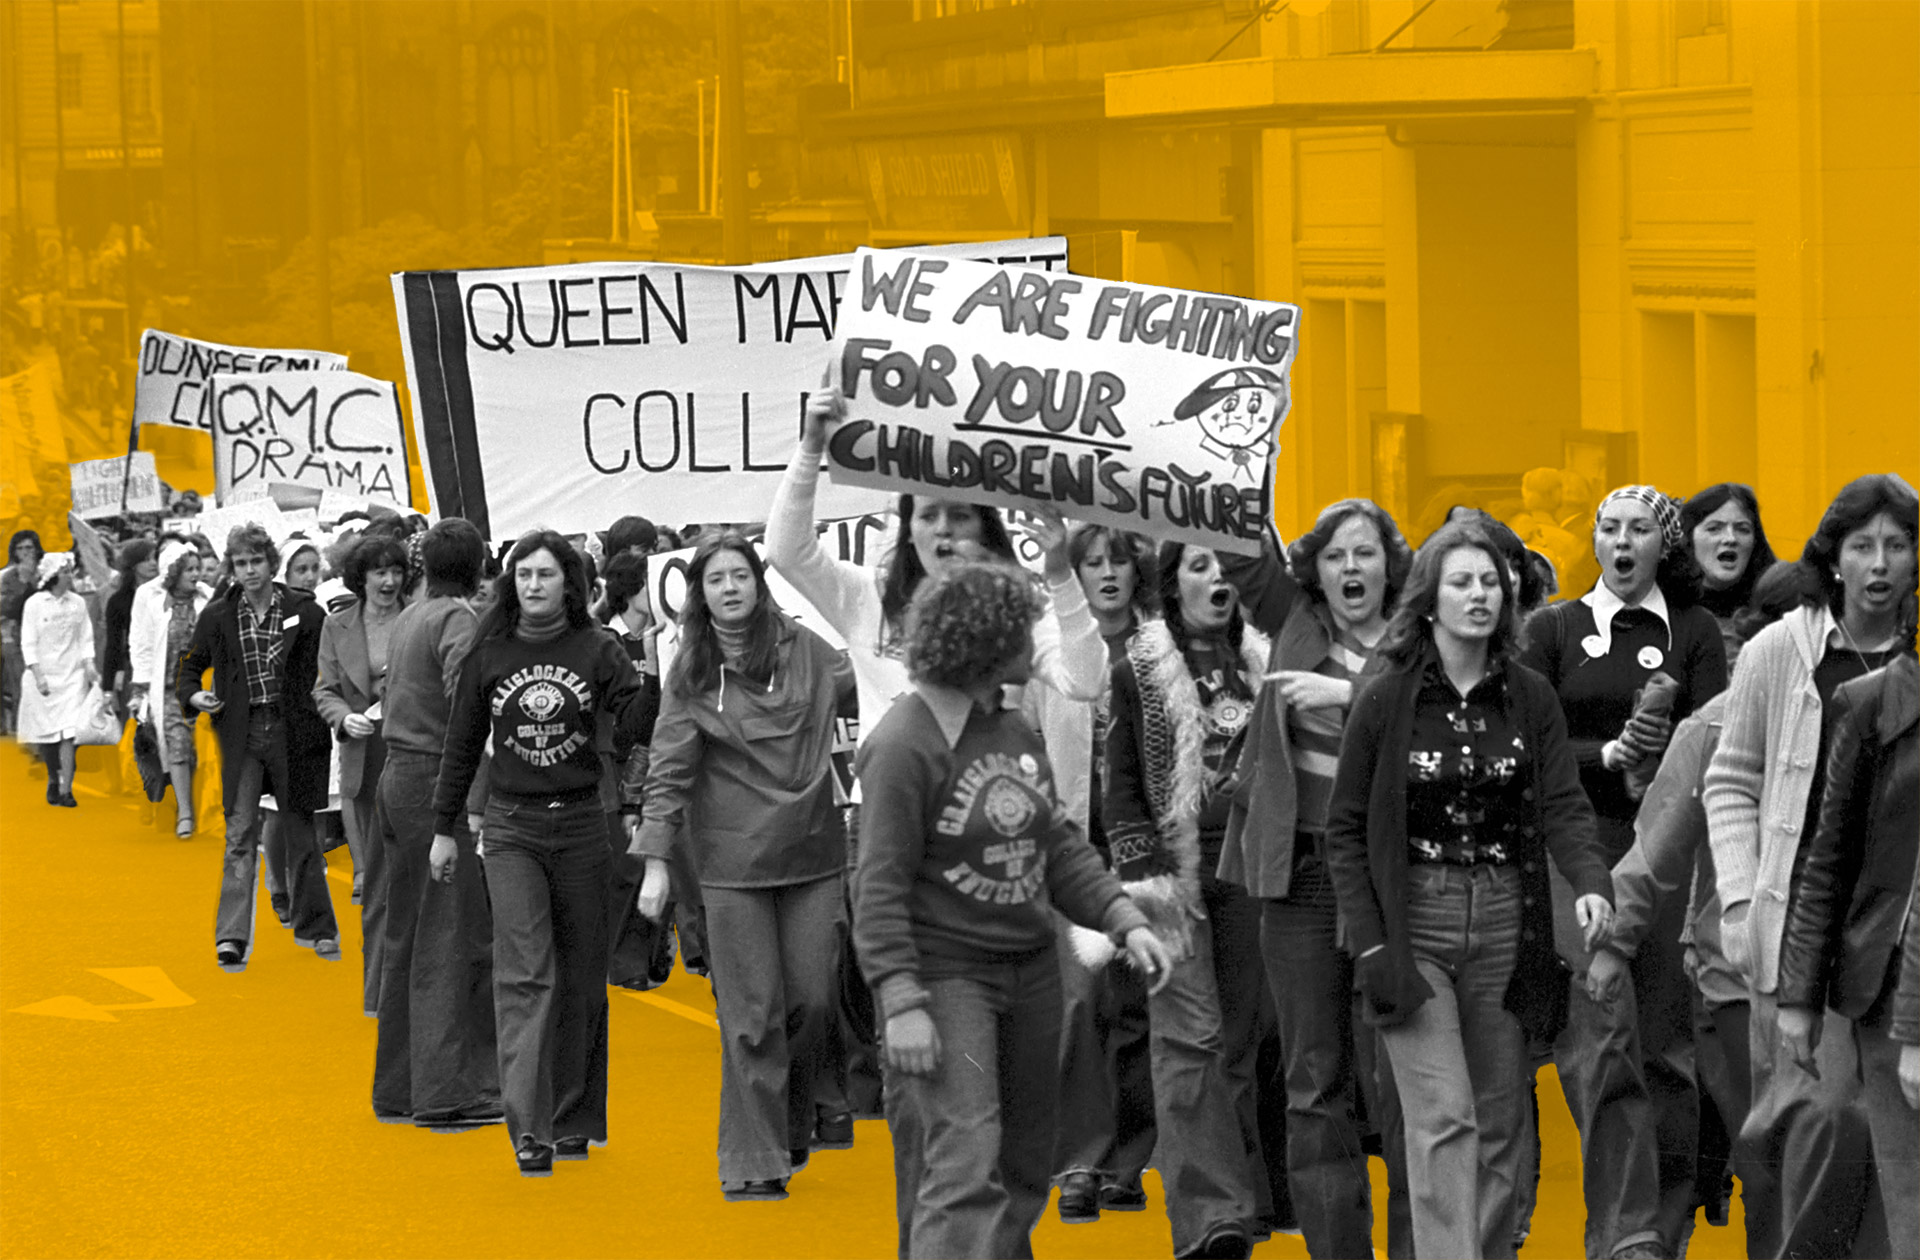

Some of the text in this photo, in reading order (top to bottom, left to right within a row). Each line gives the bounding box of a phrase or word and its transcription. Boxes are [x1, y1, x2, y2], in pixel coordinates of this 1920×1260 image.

[888, 152, 991, 197] GOLD SHIELD
[466, 272, 688, 354] QUEEN
[862, 254, 1294, 365] WE ARE FIGHTING
[218, 383, 394, 455] Q.M.C.
[841, 337, 1126, 438] FOR YOUR
[231, 438, 402, 504] DRAMA
[829, 419, 1137, 513] CHILDREN'S
[1140, 462, 1263, 540] FUTURE
